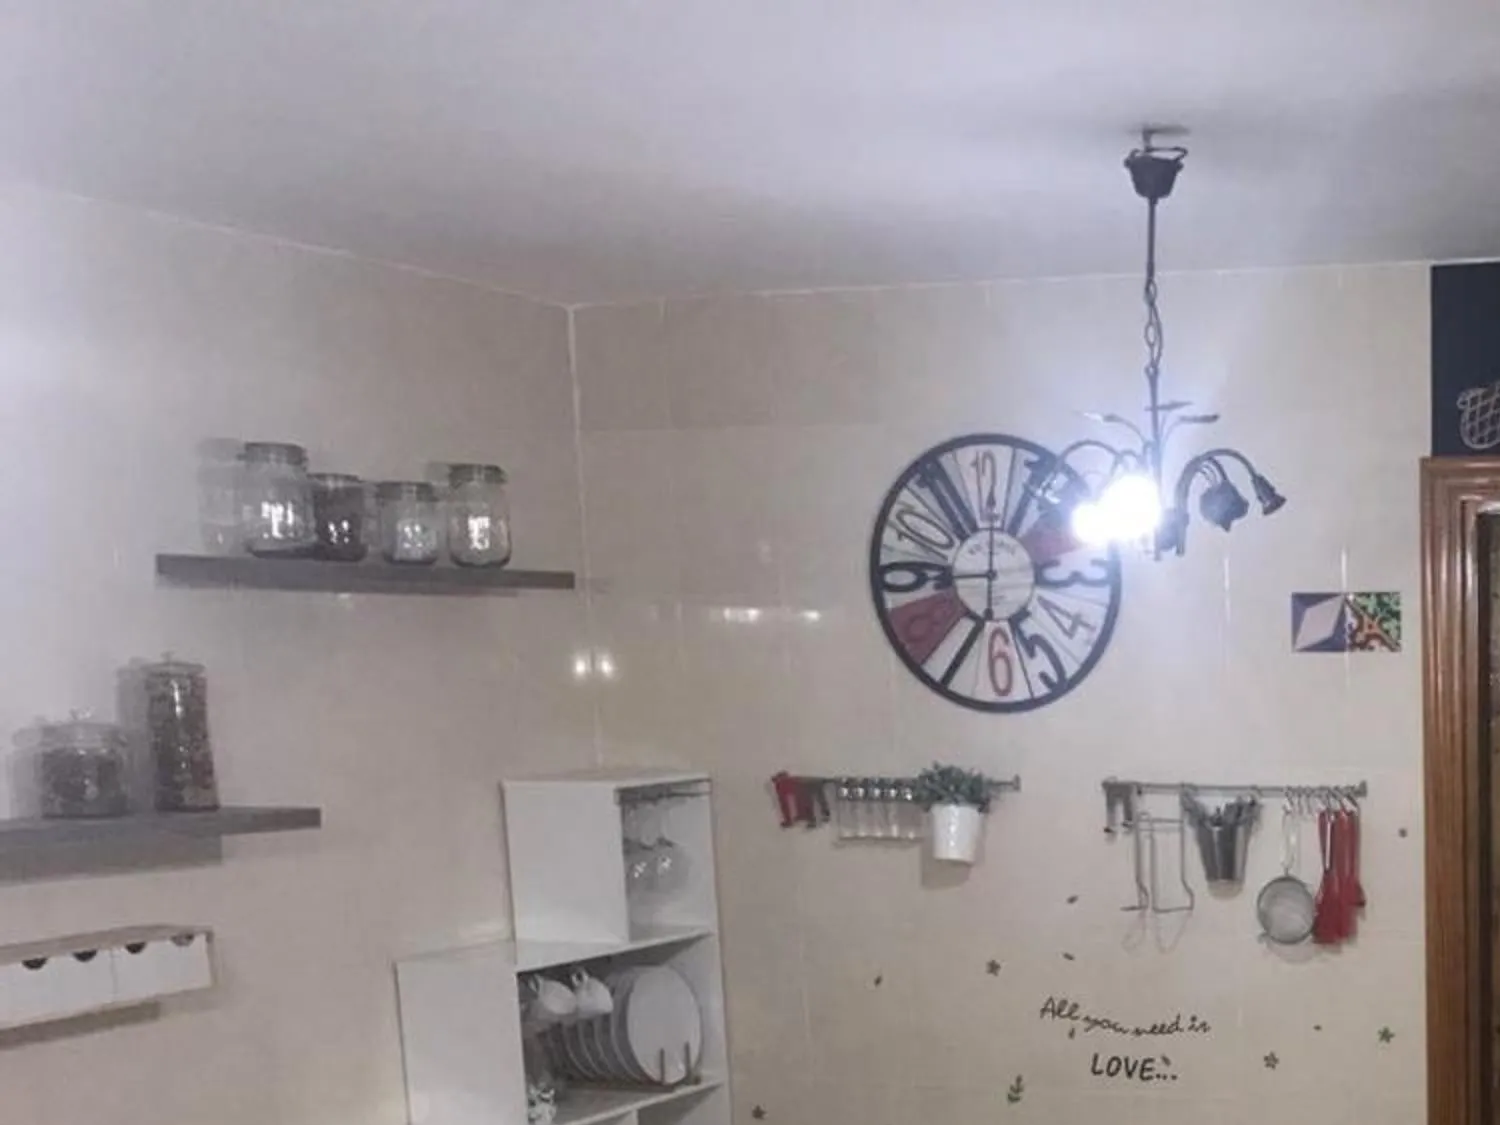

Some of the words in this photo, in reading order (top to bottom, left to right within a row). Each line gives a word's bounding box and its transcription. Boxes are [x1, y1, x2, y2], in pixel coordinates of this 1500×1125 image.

[987, 626, 1014, 698] 6
[1040, 995, 1081, 1021] All
[1131, 1012, 1185, 1038] need
